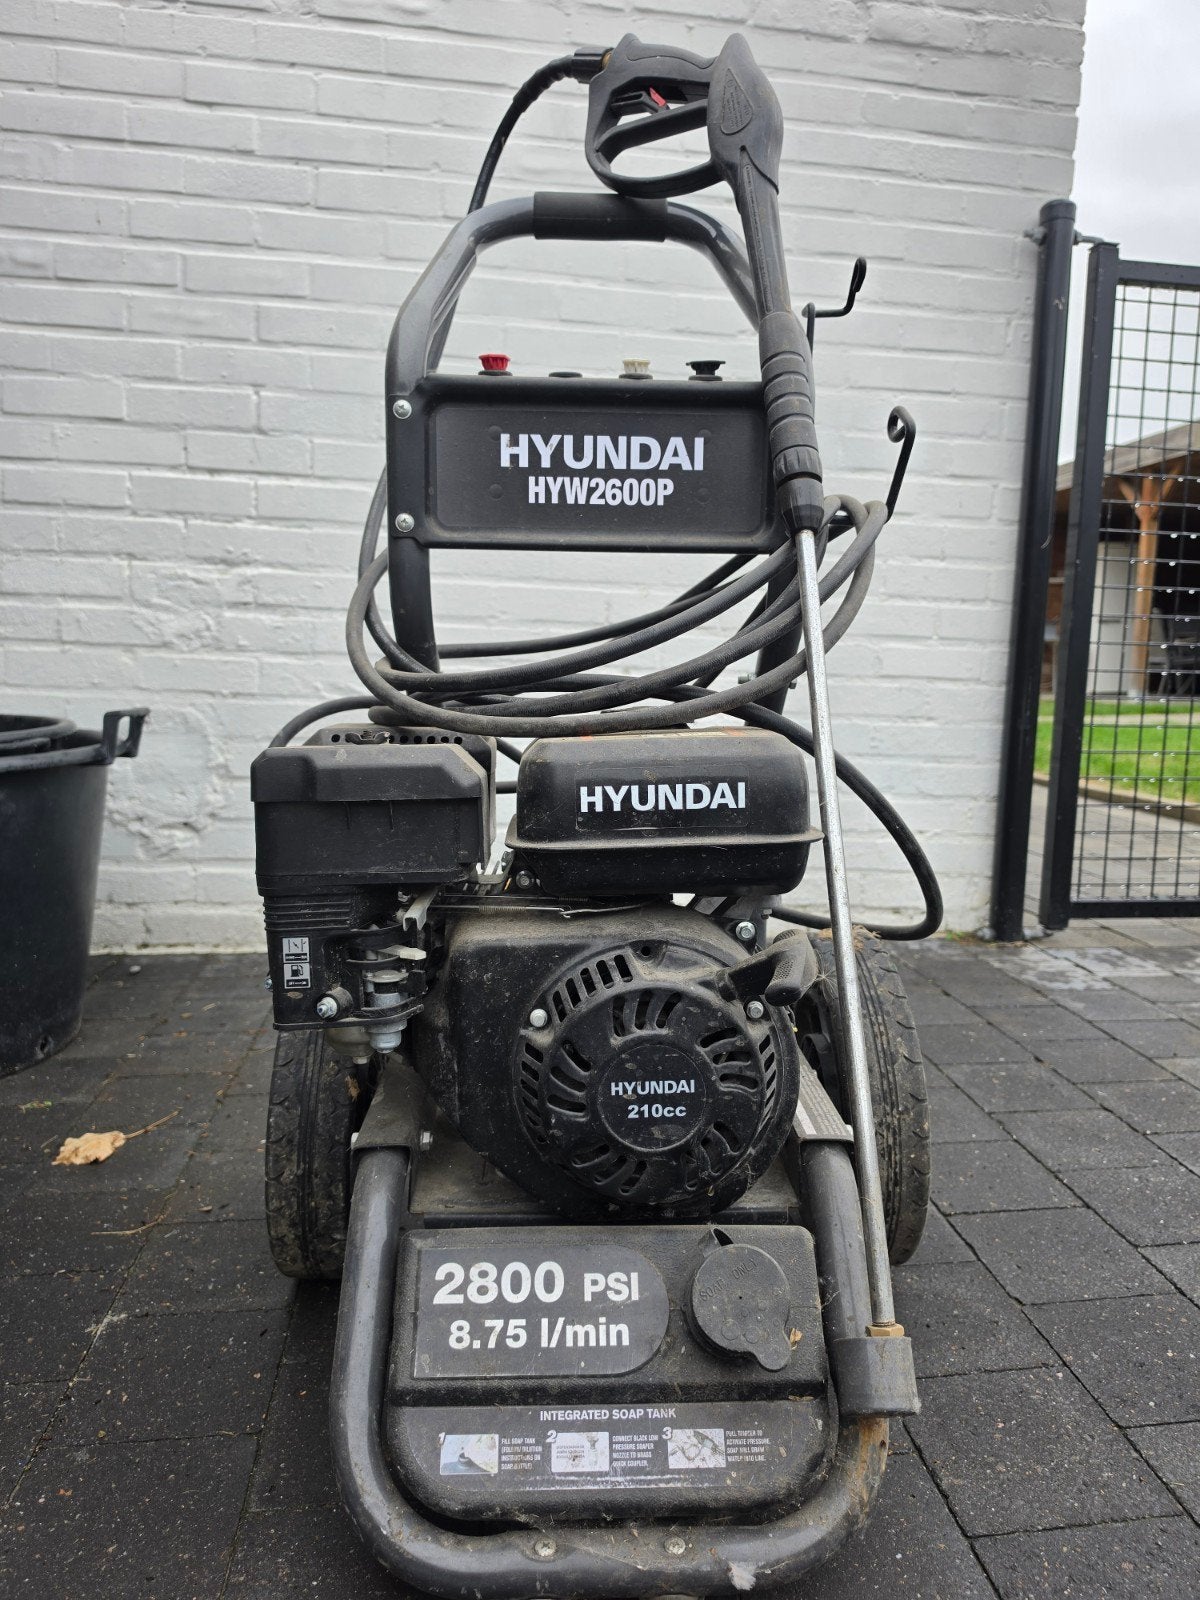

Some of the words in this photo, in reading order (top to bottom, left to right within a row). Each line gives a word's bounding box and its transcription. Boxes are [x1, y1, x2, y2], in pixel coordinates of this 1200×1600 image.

[500, 433, 705, 471] HYUNDAI
[528, 476, 675, 506] HYW2600P
[579, 782, 746, 813] HYUNDAI
[610, 1079, 695, 1096] HYUNDAI
[627, 1103, 687, 1119] 210cc
[433, 1261, 565, 1305] 2800
[584, 1271, 639, 1302] PSI
[448, 1318, 528, 1350] 8.75
[540, 1316, 630, 1348] l/min
[540, 1410, 609, 1421] INTEGRATED
[612, 1408, 644, 1419] SOAP
[646, 1407, 677, 1419] TANK
[546, 1429, 557, 1443] 2
[661, 1426, 672, 1440] 3
